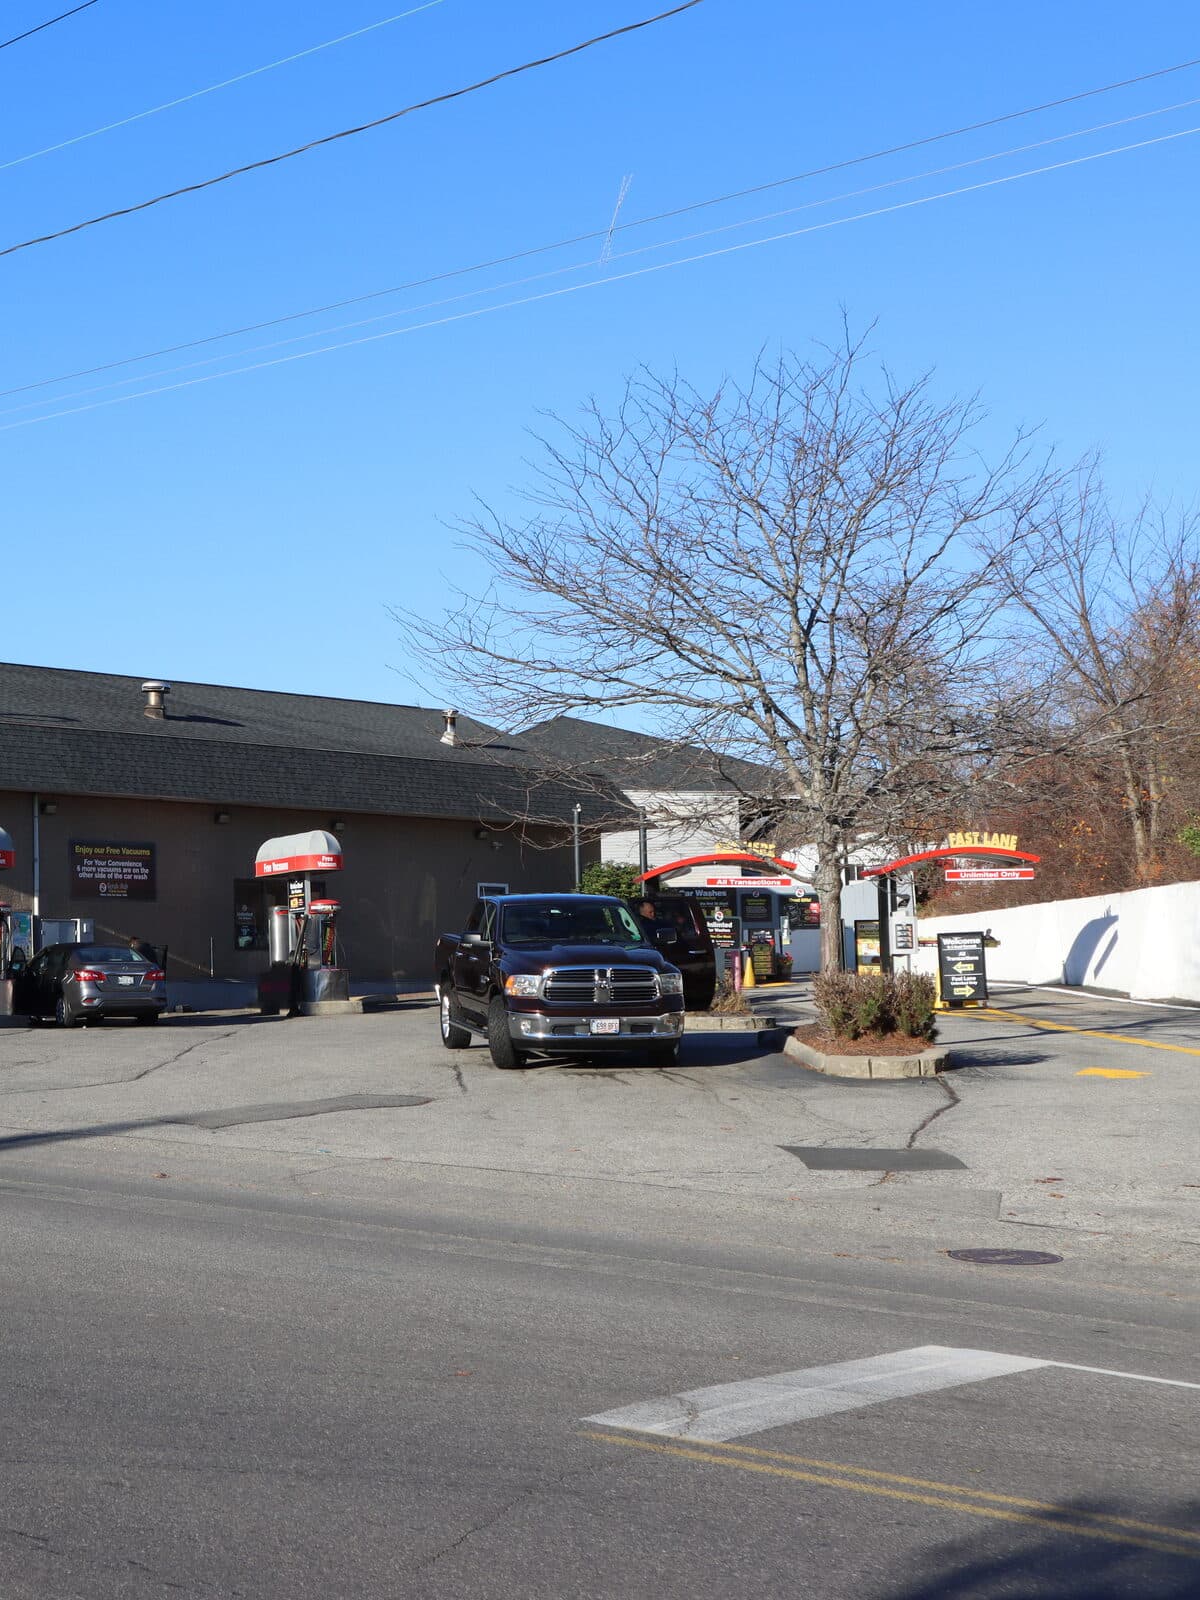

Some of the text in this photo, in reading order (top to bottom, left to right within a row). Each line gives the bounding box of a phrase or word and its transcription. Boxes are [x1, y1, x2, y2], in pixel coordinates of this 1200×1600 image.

[948, 832, 1018, 851] FAST LANE
[75, 846, 93, 855] Enjoy
[1000, 871, 1020, 879] Only
[695, 889, 727, 897] Washes
